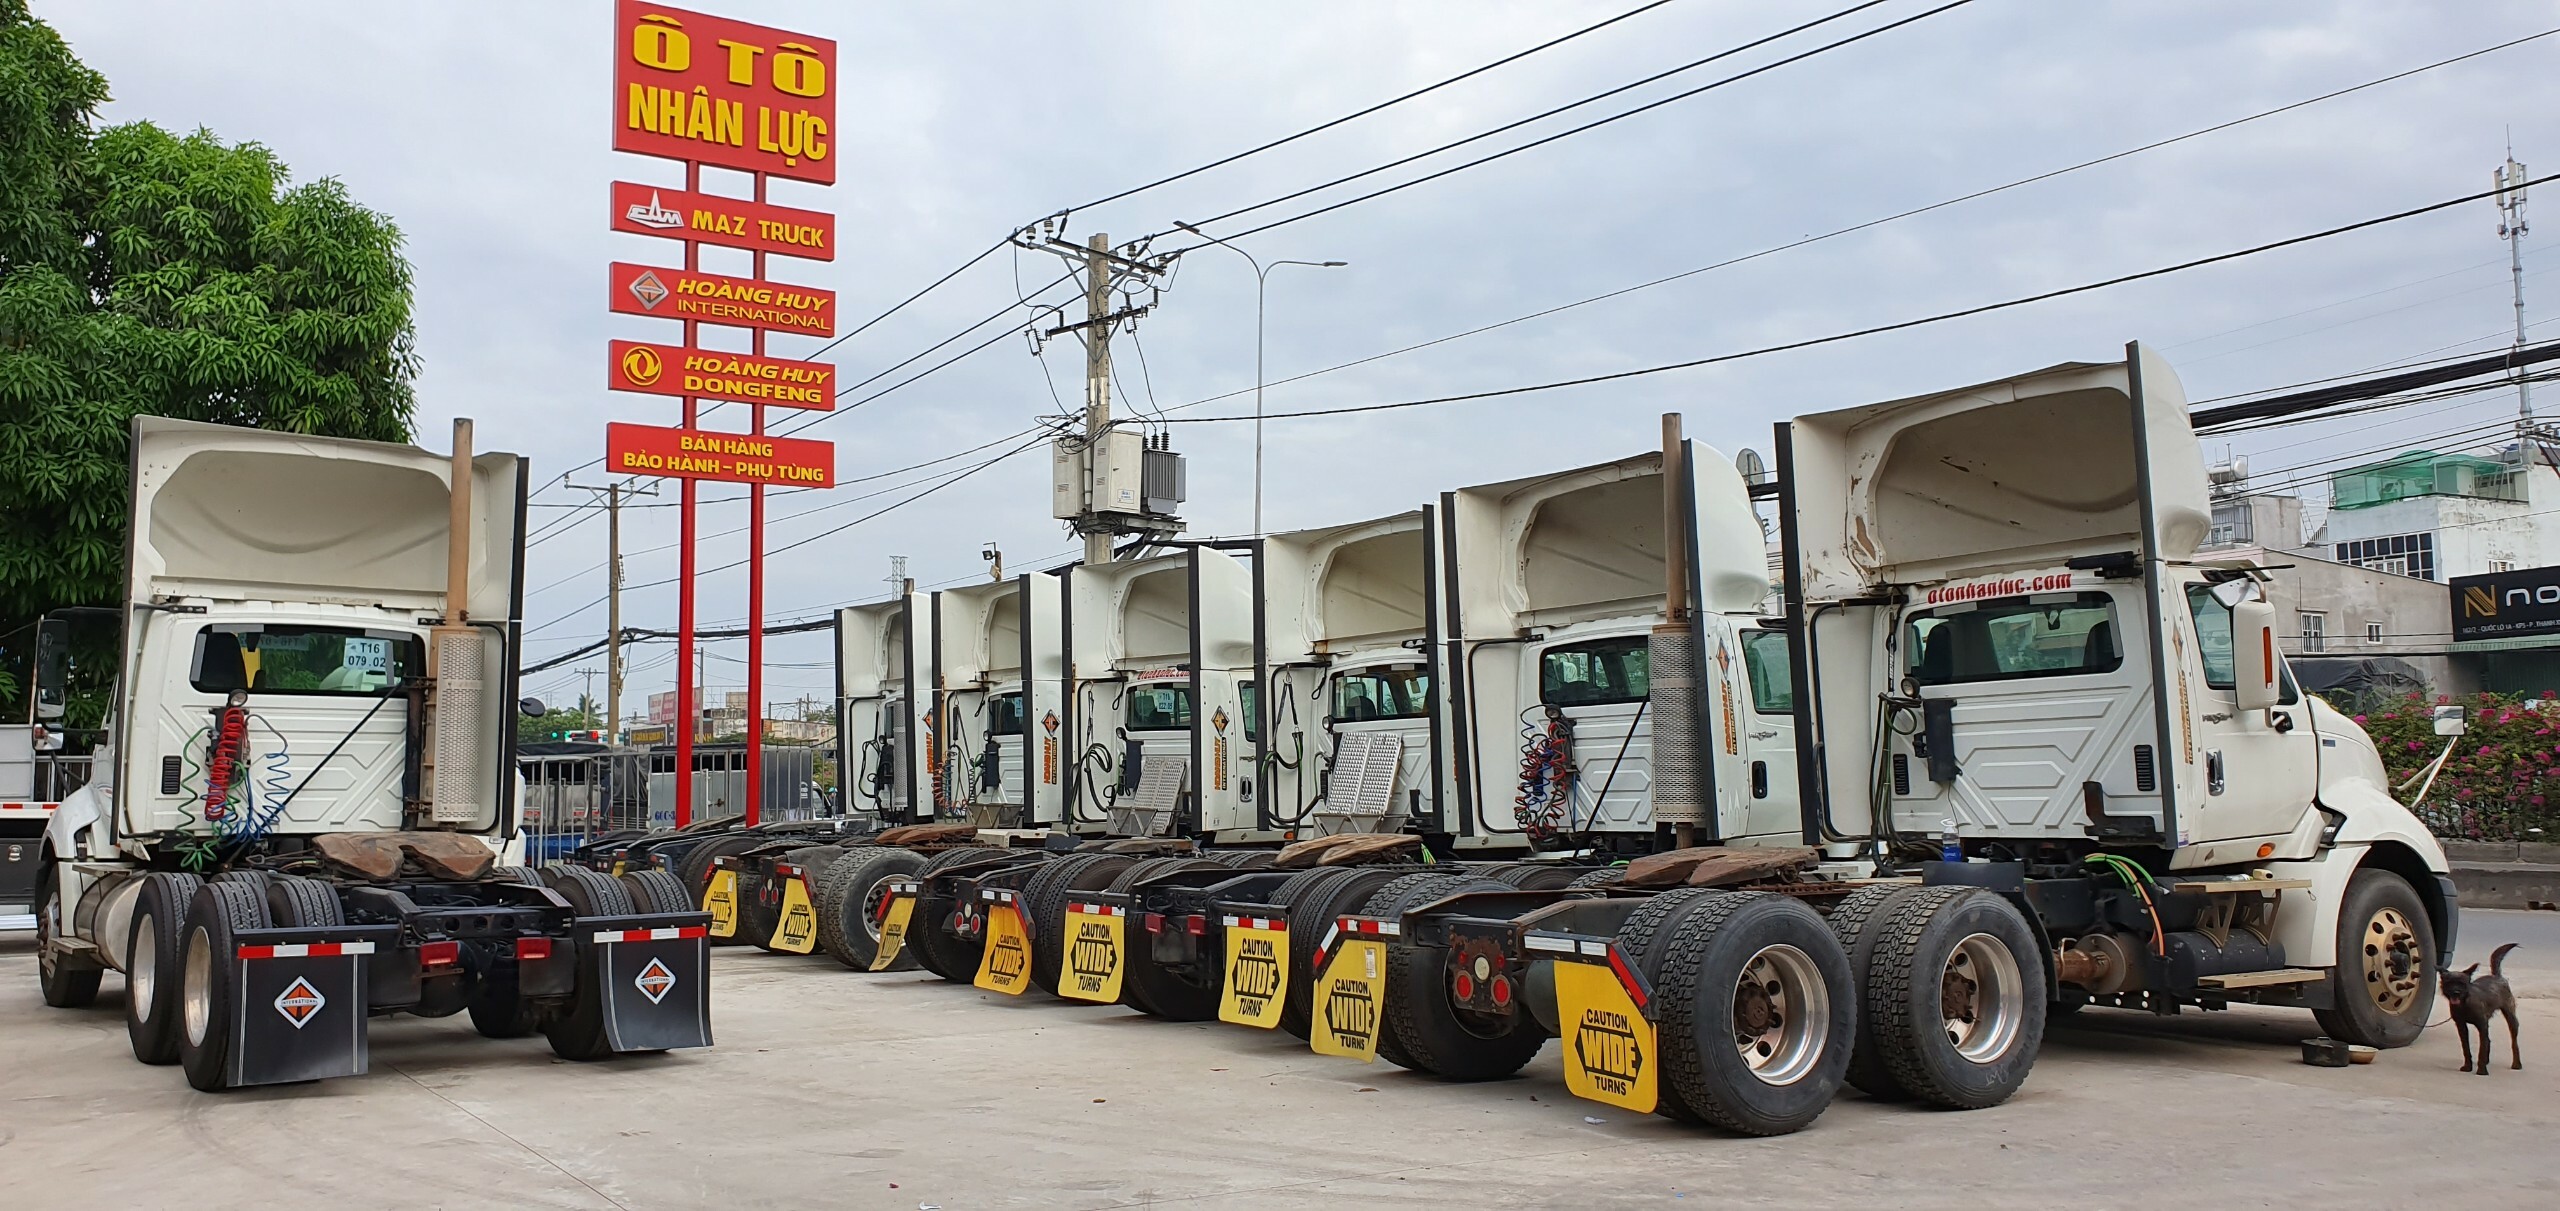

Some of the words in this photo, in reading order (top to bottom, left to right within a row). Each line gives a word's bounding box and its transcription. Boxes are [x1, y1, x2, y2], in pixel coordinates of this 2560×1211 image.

[633, 13, 690, 72] Ô
[718, 39, 826, 98] TÔ
[628, 82, 743, 147] NHÂN
[758, 106, 828, 167] LỰC
[691, 209, 747, 236] MAZ
[758, 219, 824, 248] TRUCK
[677, 278, 772, 303] HOÀNG
[775, 292, 828, 311] HUY
[677, 299, 831, 330] INTERNATIONAL
[684, 355, 779, 379] HOÀNG
[781, 367, 831, 384] HUY
[684, 375, 822, 403] DONGFENG
[681, 434, 720, 453] BÁN
[724, 438, 773, 457] HÀNG
[623, 450, 663, 469] BẢO
[667, 455, 720, 473] HÀNH
[735, 461, 773, 481] PHỤ
[777, 462, 824, 482] TÙNG
[360, 642, 380, 654] T16
[694, 733, 712, 743] KNH
[786, 914, 809, 937] WIDE
[1081, 922, 1110, 939] CAUTION
[1000, 934, 1020, 946] CAUTION
[1242, 938, 1272, 957] CAUTION
[992, 947, 1023, 974] WIDE
[1075, 941, 1113, 973] WIDE
[992, 975, 1011, 986] TURNS
[1078, 976, 1102, 992] TURNS
[1236, 959, 1276, 995] WIDE
[1335, 979, 1367, 994] CAUTION
[1238, 999, 1263, 1017] TURNS
[1331, 996, 1372, 1033] WIDE
[1586, 1009, 1627, 1030] CAUTION
[1340, 1035, 1365, 1050] TURNS
[1580, 1028, 1636, 1077] WIDE
[1595, 1076, 1626, 1096] TURNS
